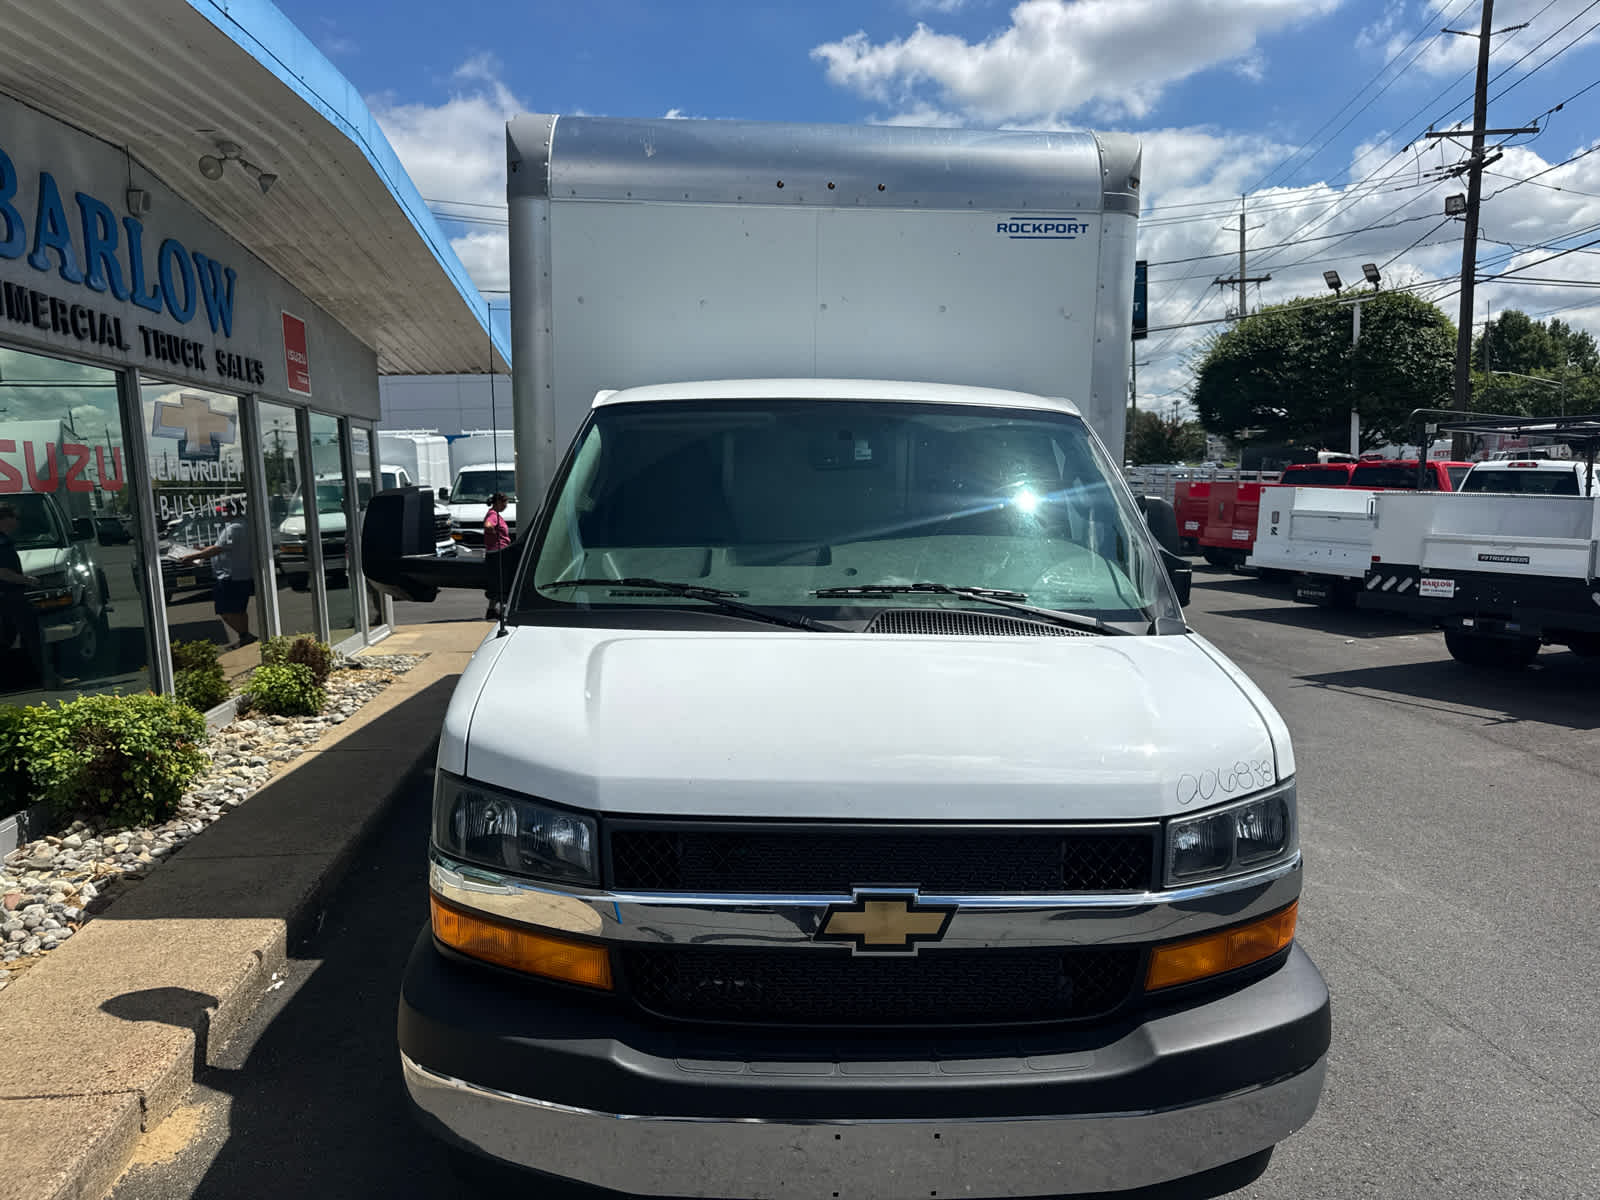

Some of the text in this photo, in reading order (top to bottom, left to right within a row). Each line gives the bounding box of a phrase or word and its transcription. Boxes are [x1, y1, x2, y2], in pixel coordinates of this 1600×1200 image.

[996, 223, 1089, 234] ROCKPORT
[0, 281, 265, 385] MERCIAL TRUCK SALES
[157, 457, 244, 482] CHEVROLET
[160, 494, 248, 521] BUSINESS
[184, 522, 233, 548] ELITE
[1421, 580, 1454, 588] BARLOW
